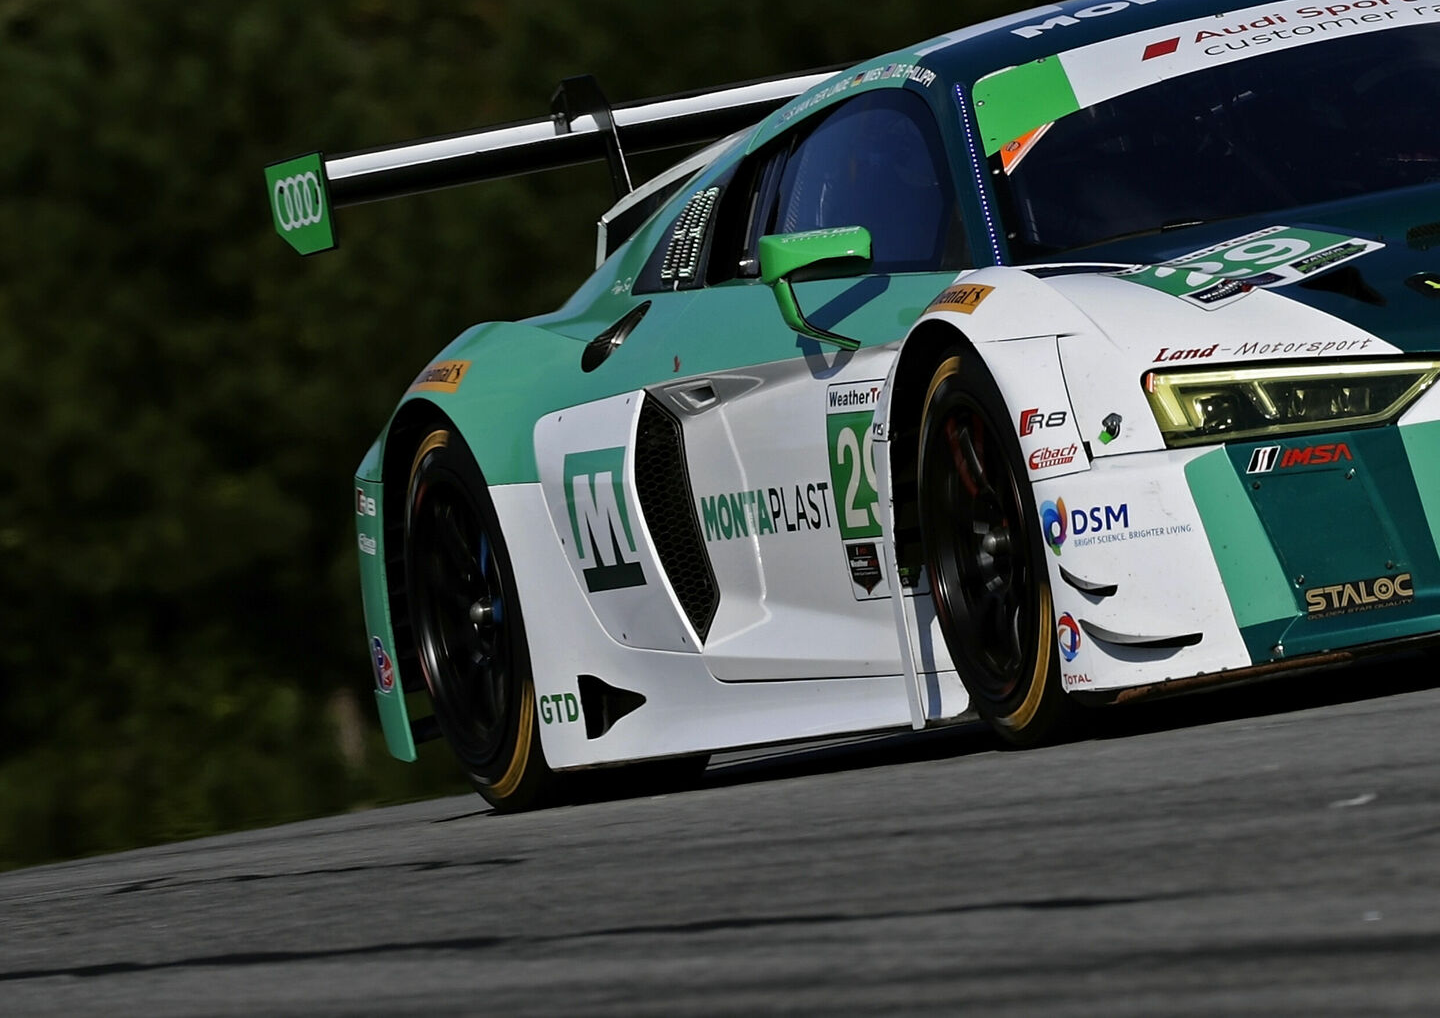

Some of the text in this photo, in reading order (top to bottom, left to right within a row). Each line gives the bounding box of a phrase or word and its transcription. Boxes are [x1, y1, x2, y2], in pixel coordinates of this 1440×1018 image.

[1194, 13, 1288, 44] Audi
[1203, 9, 1400, 57] customer
[1024, 410, 1068, 431] R8
[1028, 443, 1078, 471] Eibach
[1281, 443, 1353, 469] IMSA
[701, 482, 832, 542] MONTAPLAST
[1071, 503, 1130, 535] DSM
[1074, 537, 1096, 548] BRIGHT
[1128, 527, 1165, 540] BRIGHTER
[1305, 573, 1414, 613] STALOC
[1063, 671, 1092, 686] TOTAL
[540, 692, 579, 725] GTD
